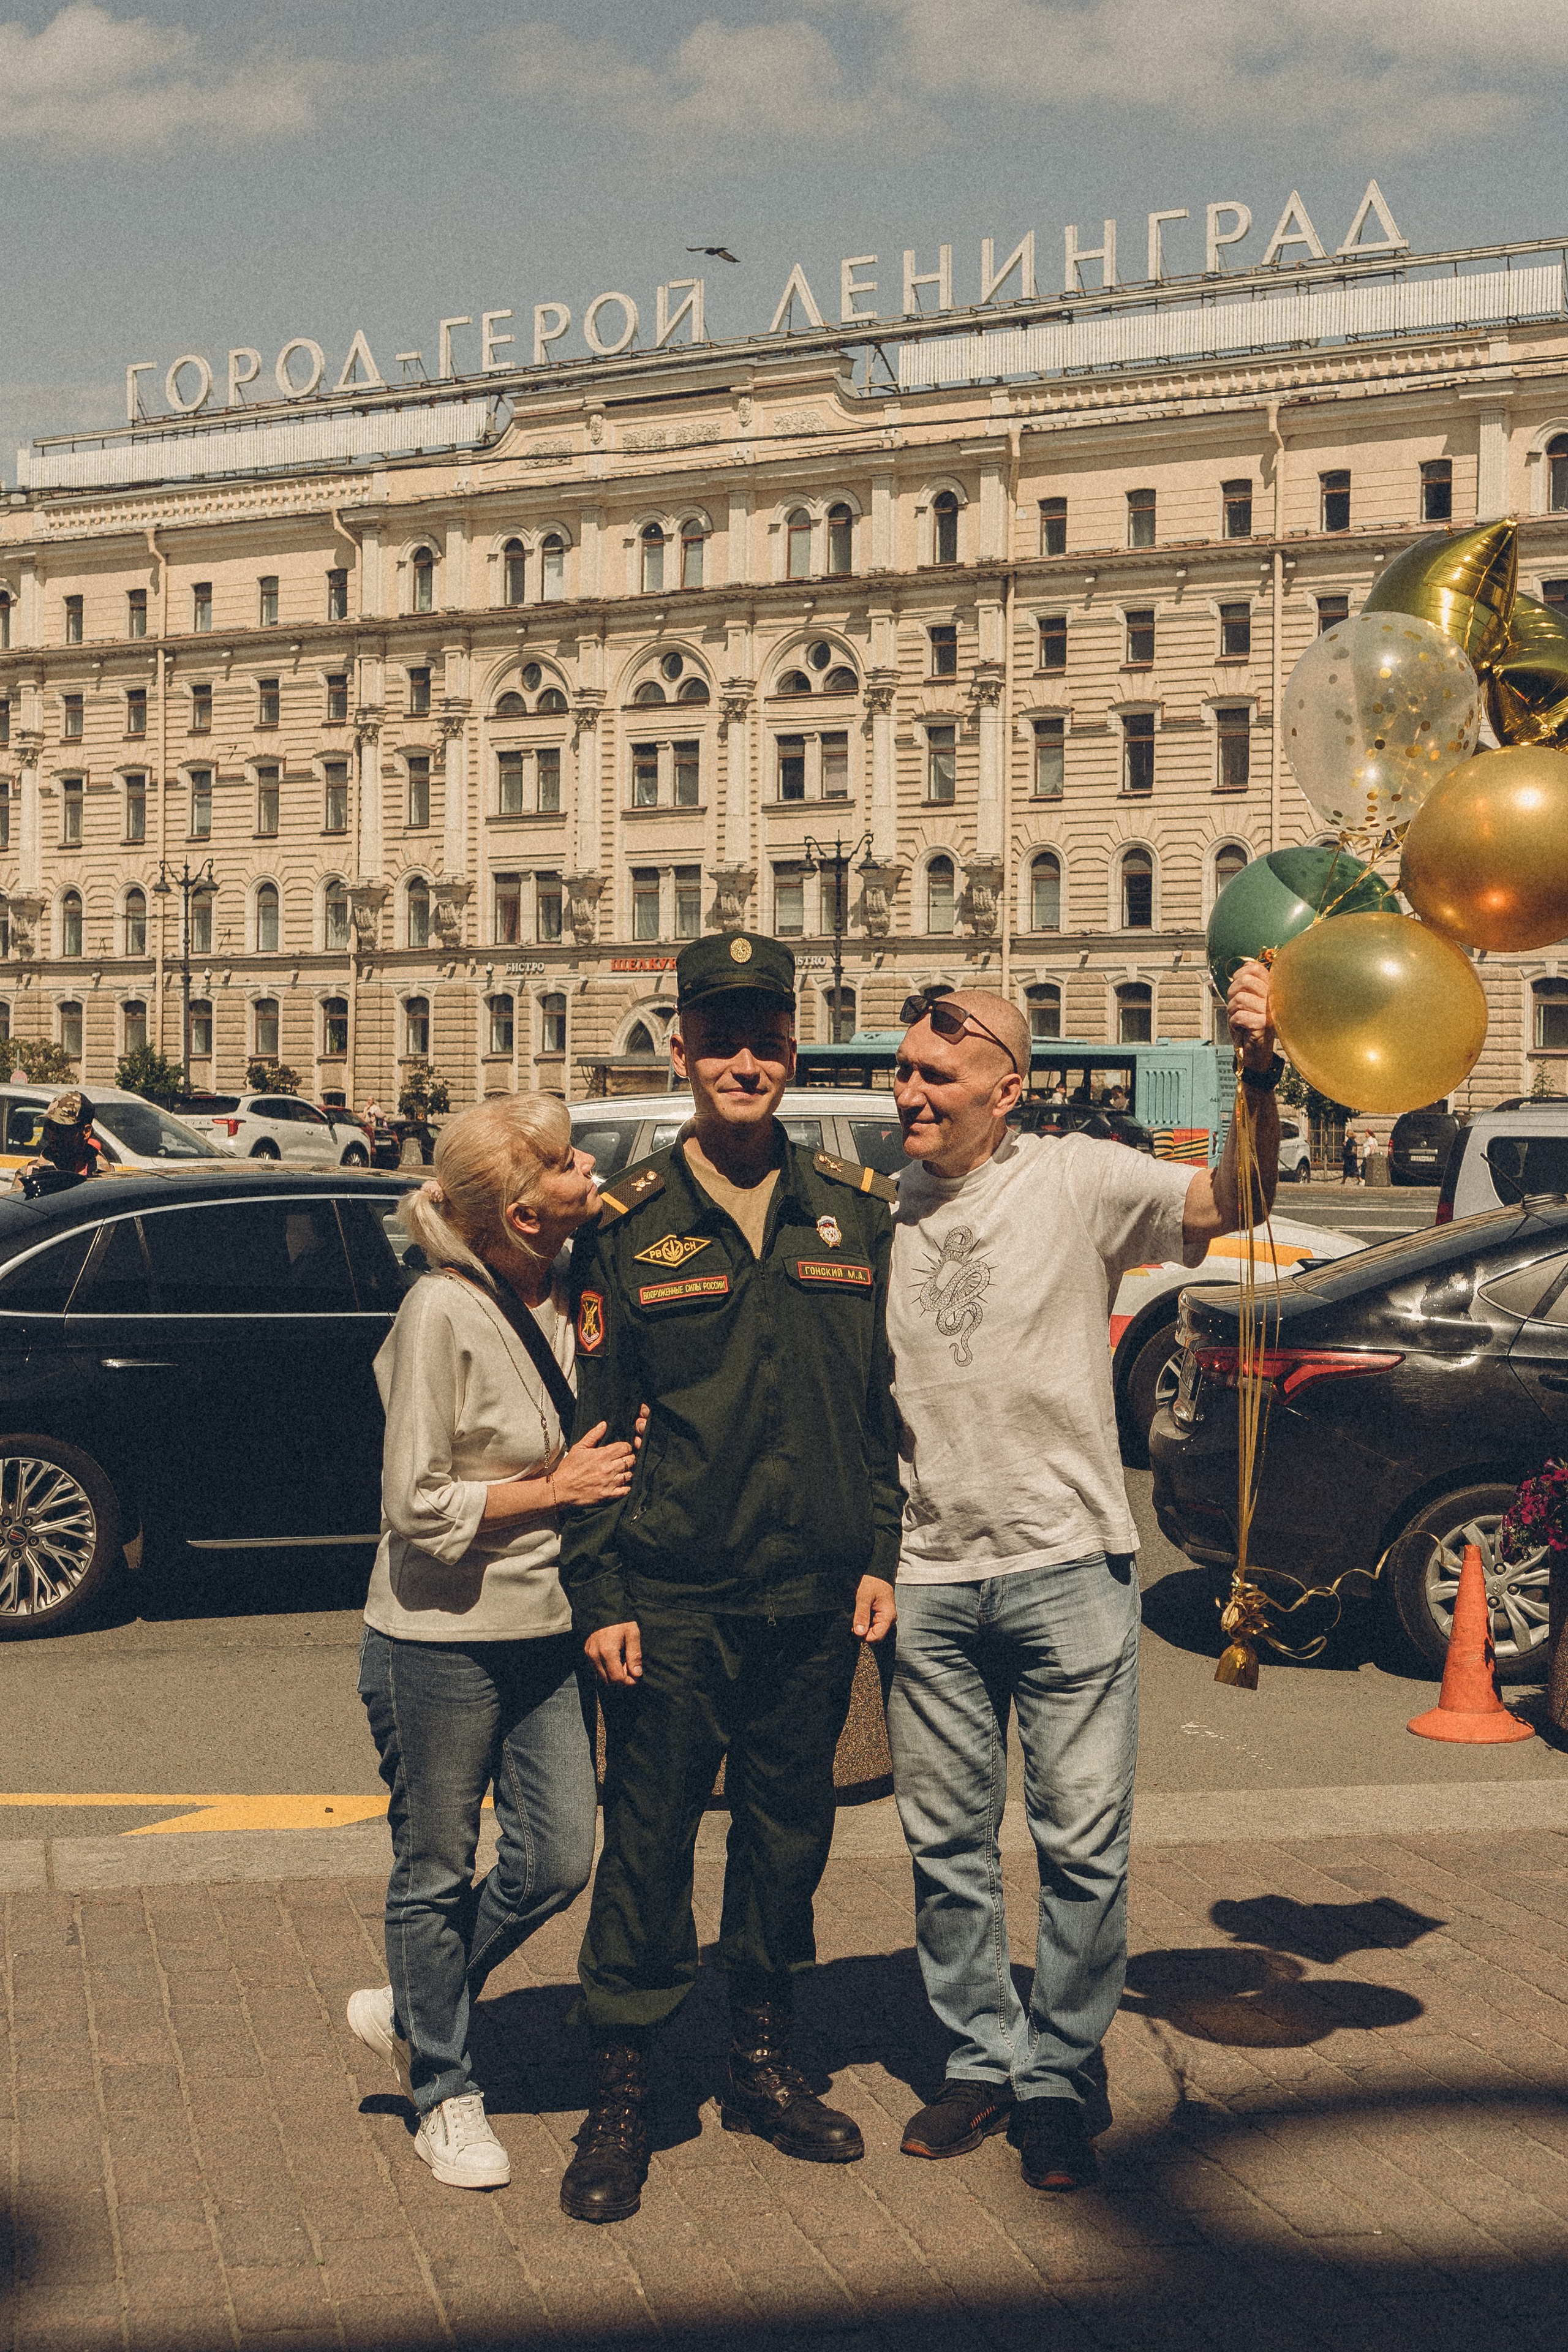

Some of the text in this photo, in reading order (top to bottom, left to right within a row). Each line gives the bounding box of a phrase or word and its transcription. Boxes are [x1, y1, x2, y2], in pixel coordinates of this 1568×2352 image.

[126, 179, 1409, 420] ГОРОД-ГЕРОЙ ЛЕНИНГРАД
[505, 962, 545, 972] БИСТРО
[649, 1240, 696, 1259] РВ СН
[805, 1266, 866, 1281] ГОНСКИЙ М.А.
[643, 1280, 725, 1300] ВООРУЖЕННЫЕ СИЛЫ РОССИИ
